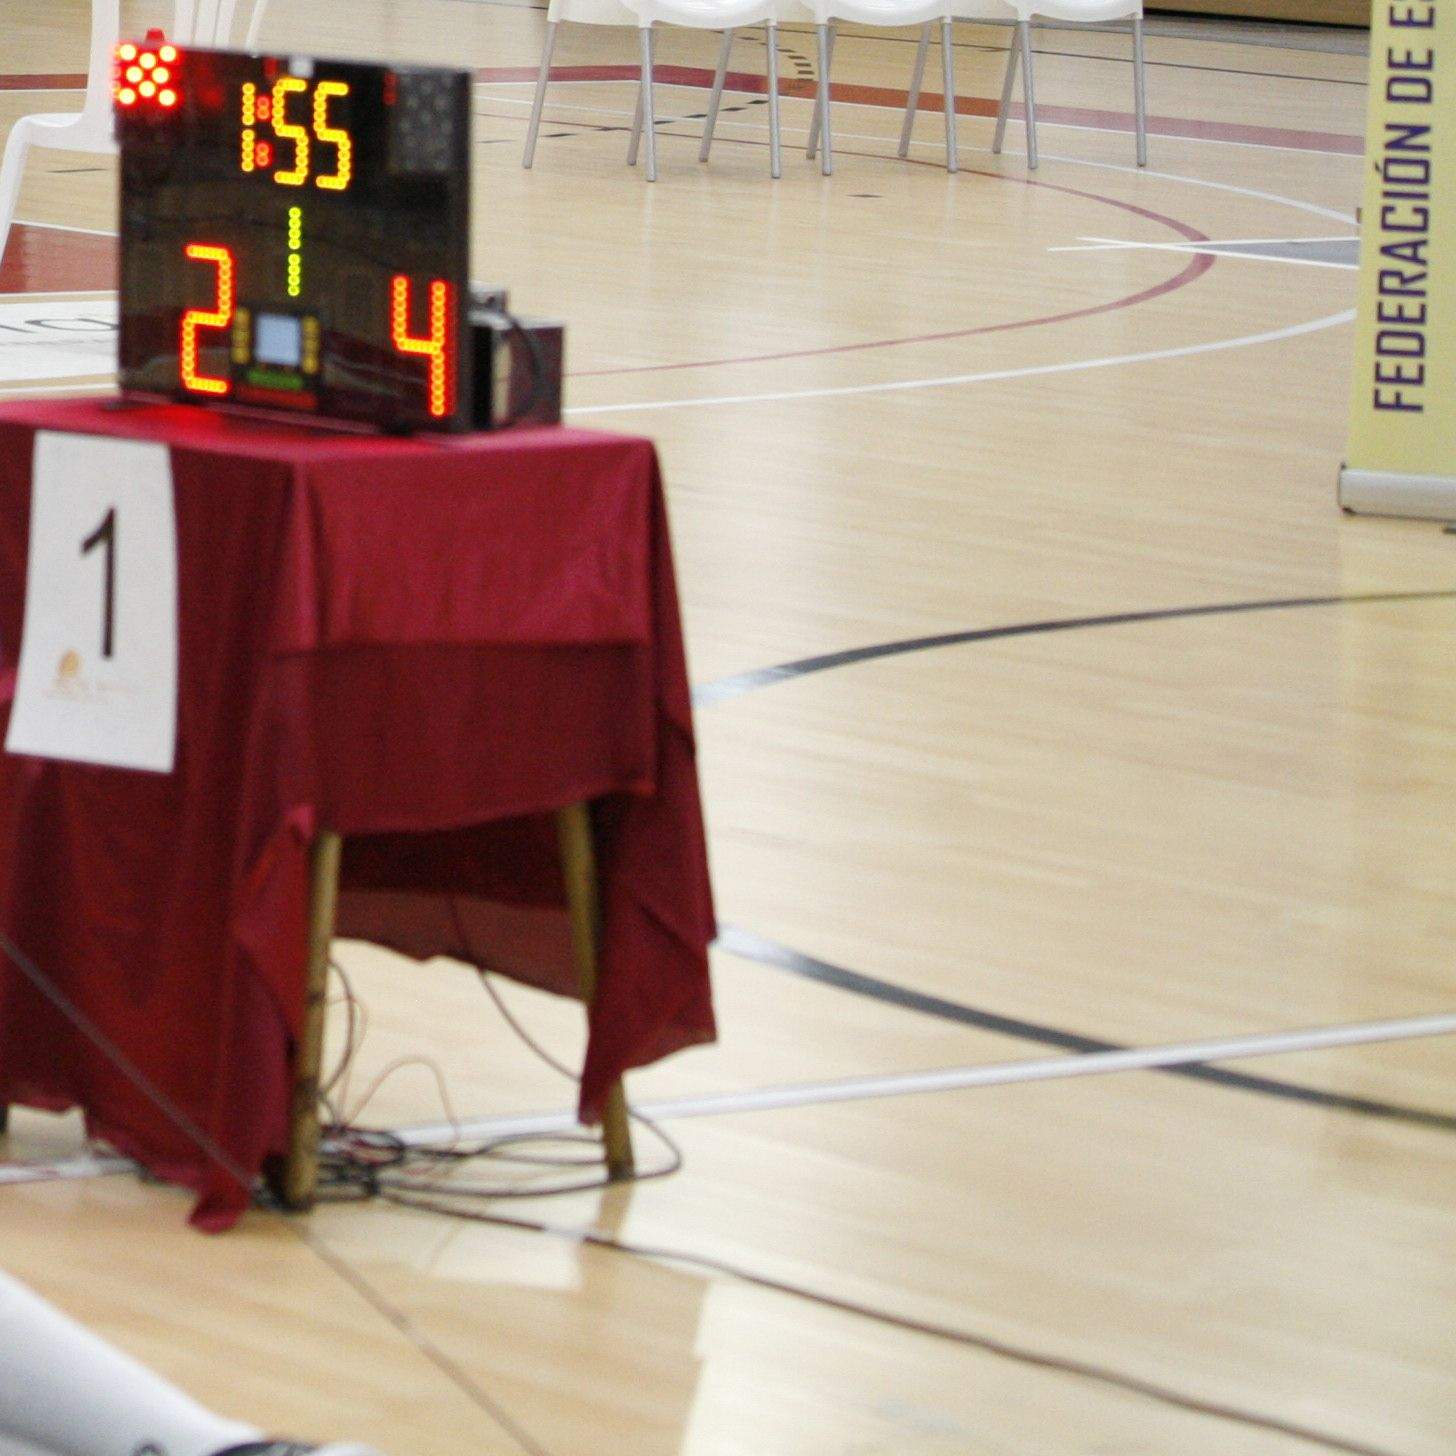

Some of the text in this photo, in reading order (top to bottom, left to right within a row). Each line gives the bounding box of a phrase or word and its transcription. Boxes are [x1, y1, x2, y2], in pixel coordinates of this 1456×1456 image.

[240, 76, 351, 191] 1:55
[1385, 48, 1434, 105] DE
[181, 243, 234, 396] 2
[1373, 121, 1432, 413] FEDERACIÓN
[392, 273, 452, 418] 4
[81, 506, 116, 660] 1
